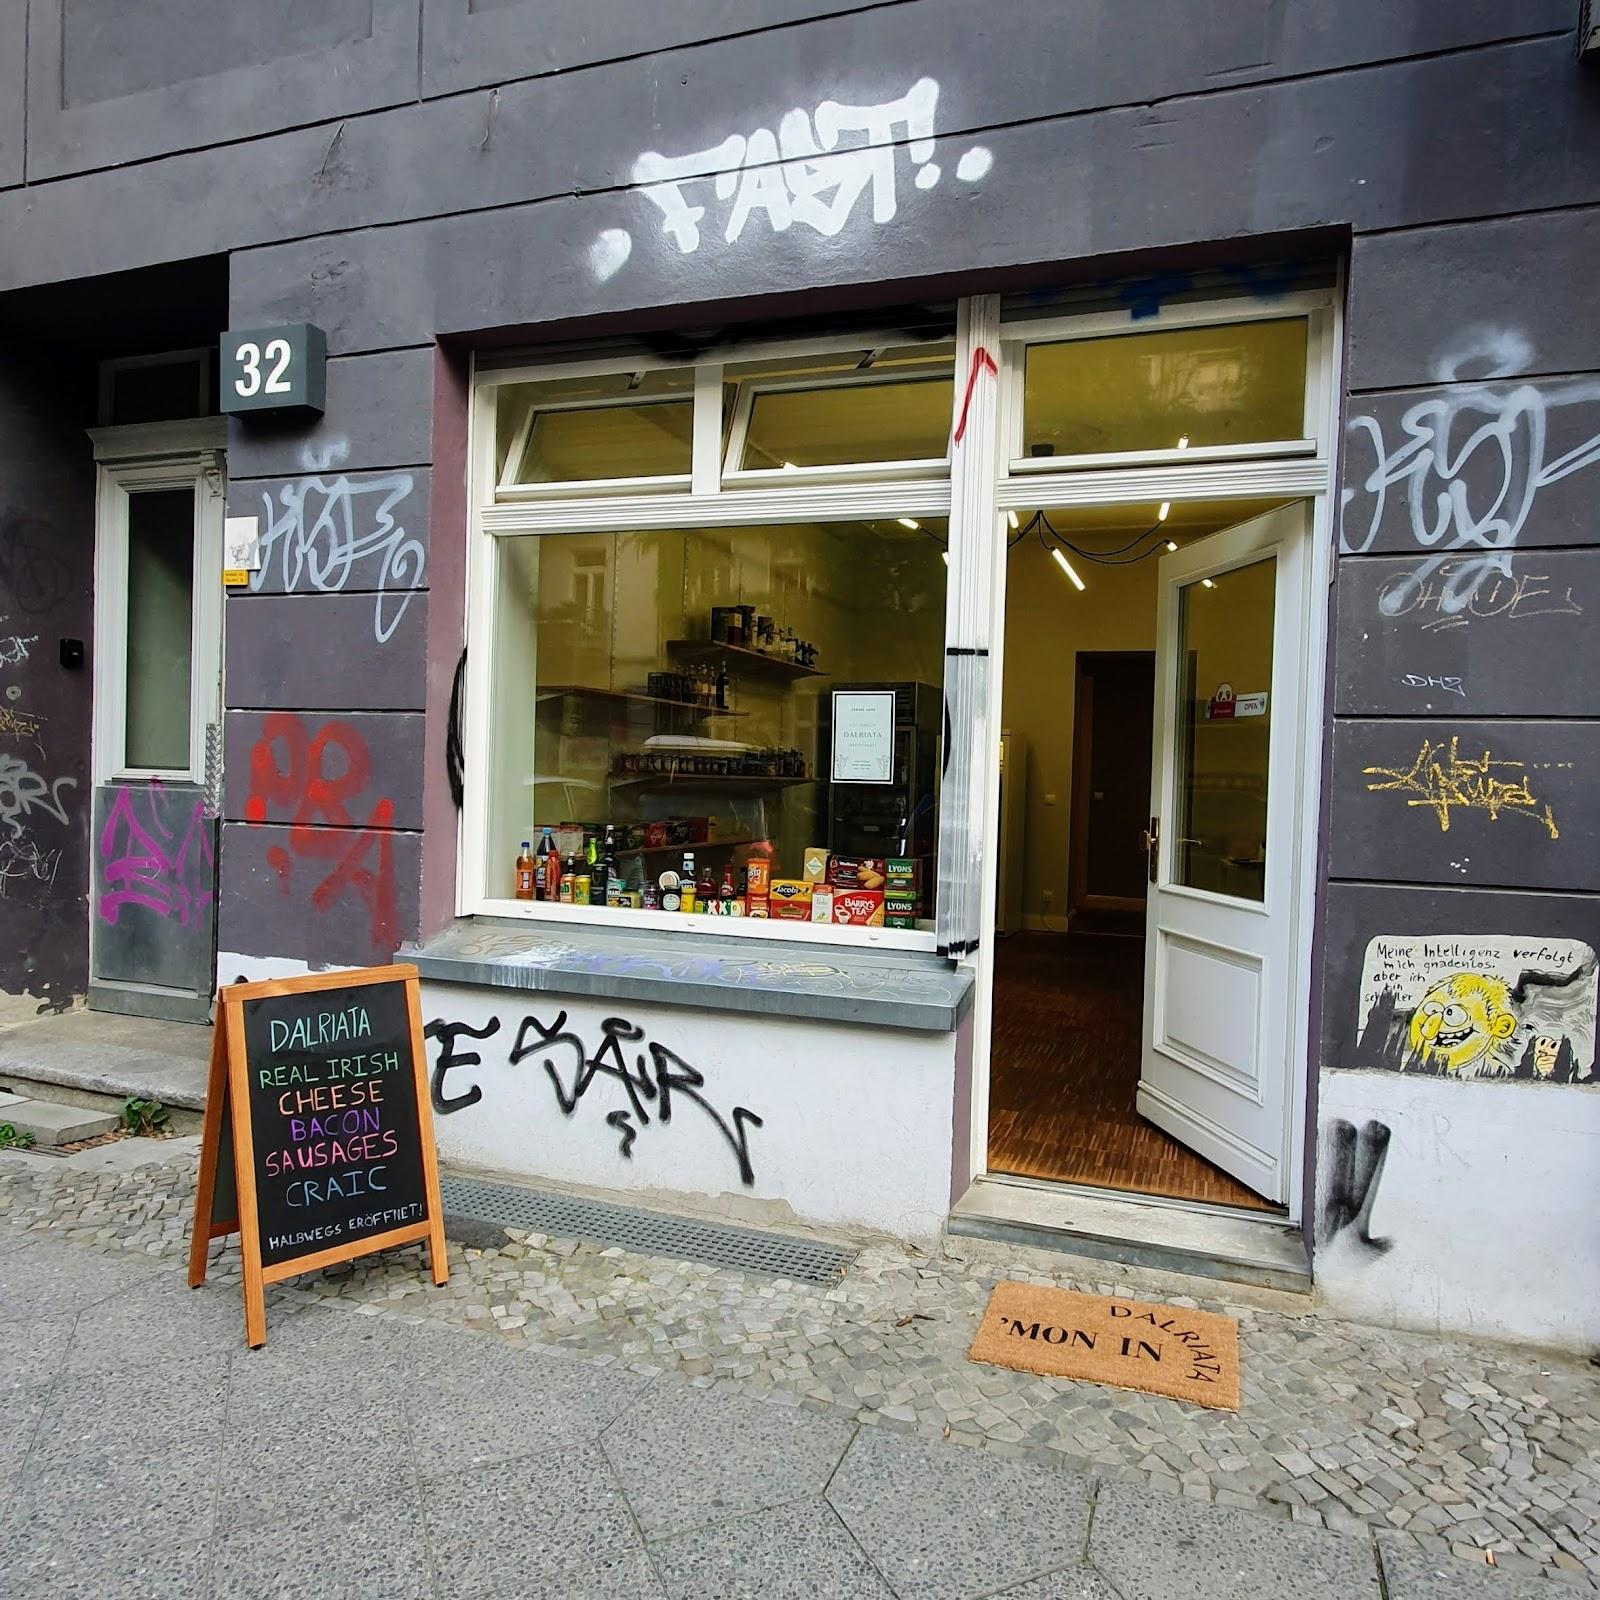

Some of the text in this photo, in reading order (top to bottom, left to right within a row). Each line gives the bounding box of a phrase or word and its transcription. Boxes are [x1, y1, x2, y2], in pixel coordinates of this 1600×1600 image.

[235, 339, 291, 397] 32
[1244, 703, 1258, 711] OPEN
[843, 731, 882, 739] DALRIATA
[888, 865, 912, 873] LYONS
[845, 897, 875, 911] BARRY'S
[851, 907, 867, 916] TEA
[887, 902, 912, 911] LYONS
[1377, 942, 1574, 968] Meine Intelligenz verfolgt
[1384, 959, 1415, 970] mich
[1373, 972, 1426, 983] aber ich
[271, 1006, 371, 1053] DALRIATA
[260, 1051, 400, 1090] REAL IRISH
[279, 1080, 385, 1116] CHEESE
[291, 1107, 381, 1142] BACON
[266, 1130, 399, 1177] SAUSAGES
[286, 1166, 387, 1207] CRAIC
[269, 1224, 342, 1251] HALBWEGS
[1110, 1305, 1222, 1383] DALRIATA
[1119, 1337, 1164, 1363] IN
